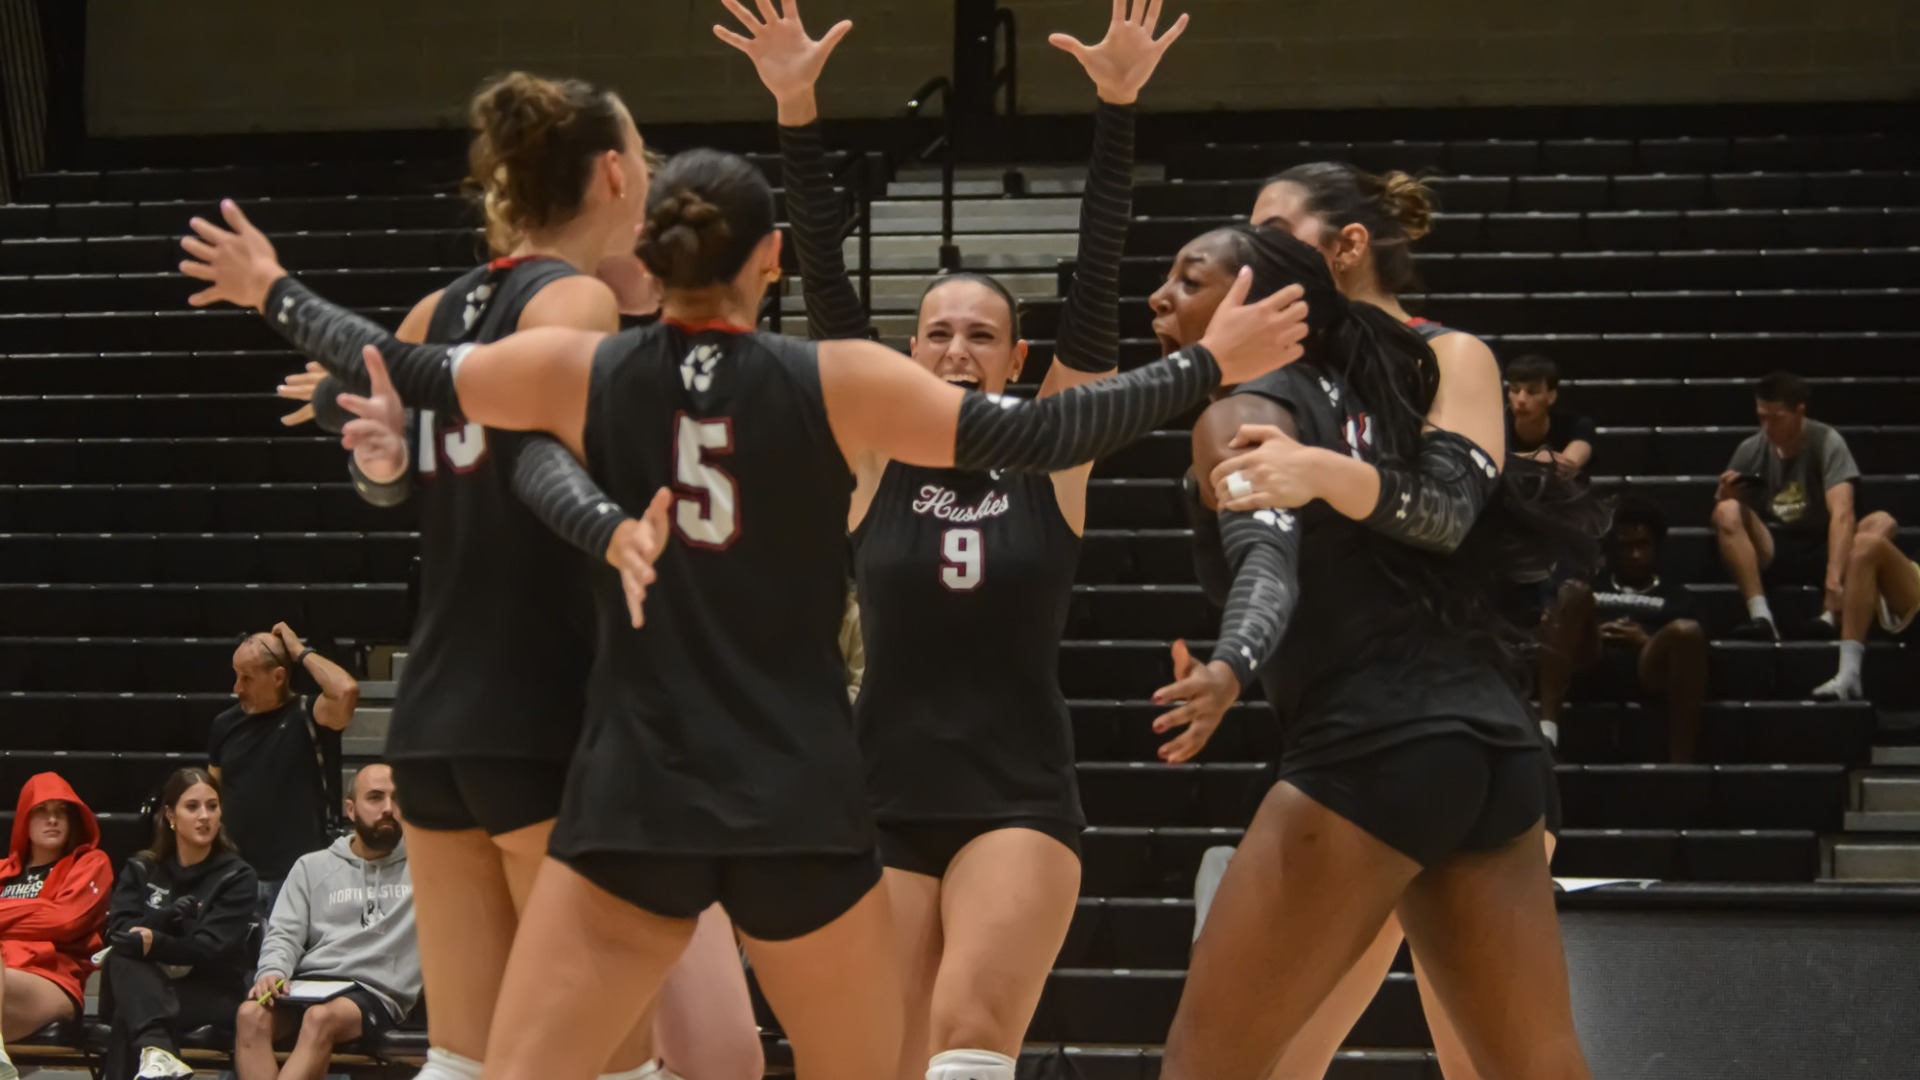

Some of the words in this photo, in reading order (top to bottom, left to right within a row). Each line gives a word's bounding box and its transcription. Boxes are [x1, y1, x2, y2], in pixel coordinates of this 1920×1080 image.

[672, 411, 742, 549] 5
[912, 484, 1010, 522] Huskies
[939, 526, 985, 591] 9
